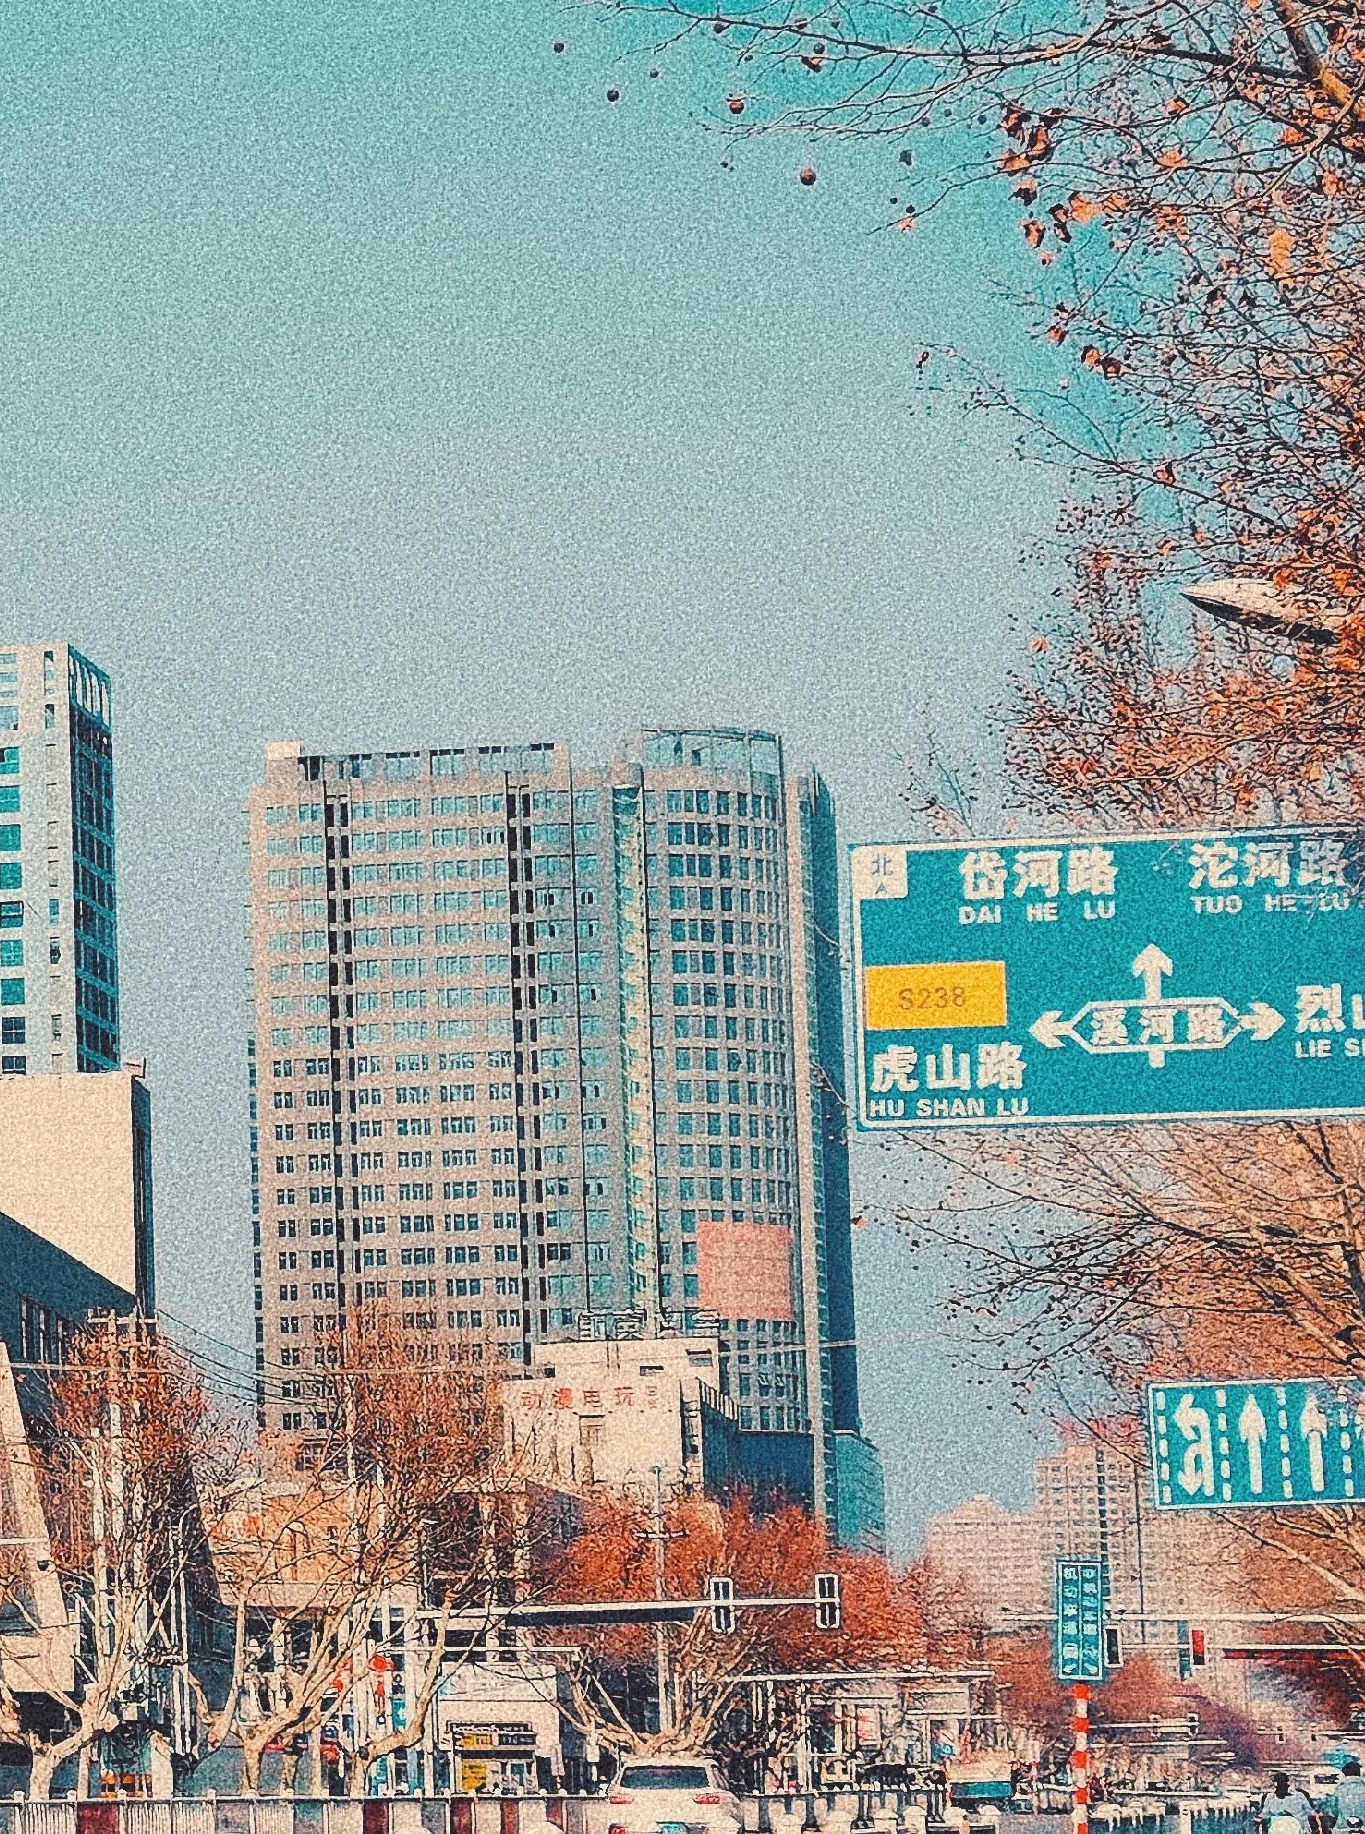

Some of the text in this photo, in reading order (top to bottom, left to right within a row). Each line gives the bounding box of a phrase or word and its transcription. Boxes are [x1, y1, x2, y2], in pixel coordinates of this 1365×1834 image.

[871, 852, 894, 876] 北
[959, 846, 1119, 899] 岱河路
[1188, 839, 1350, 890] 沱河路
[959, 899, 1116, 925] DAI HE LU
[1189, 891, 1350, 914] TUO HE LU
[899, 986, 966, 1010] S238
[1295, 1038, 1332, 1058] LIE
[870, 1041, 1027, 1093] 虎山路
[869, 1096, 1029, 1117] HU SHAN LU
